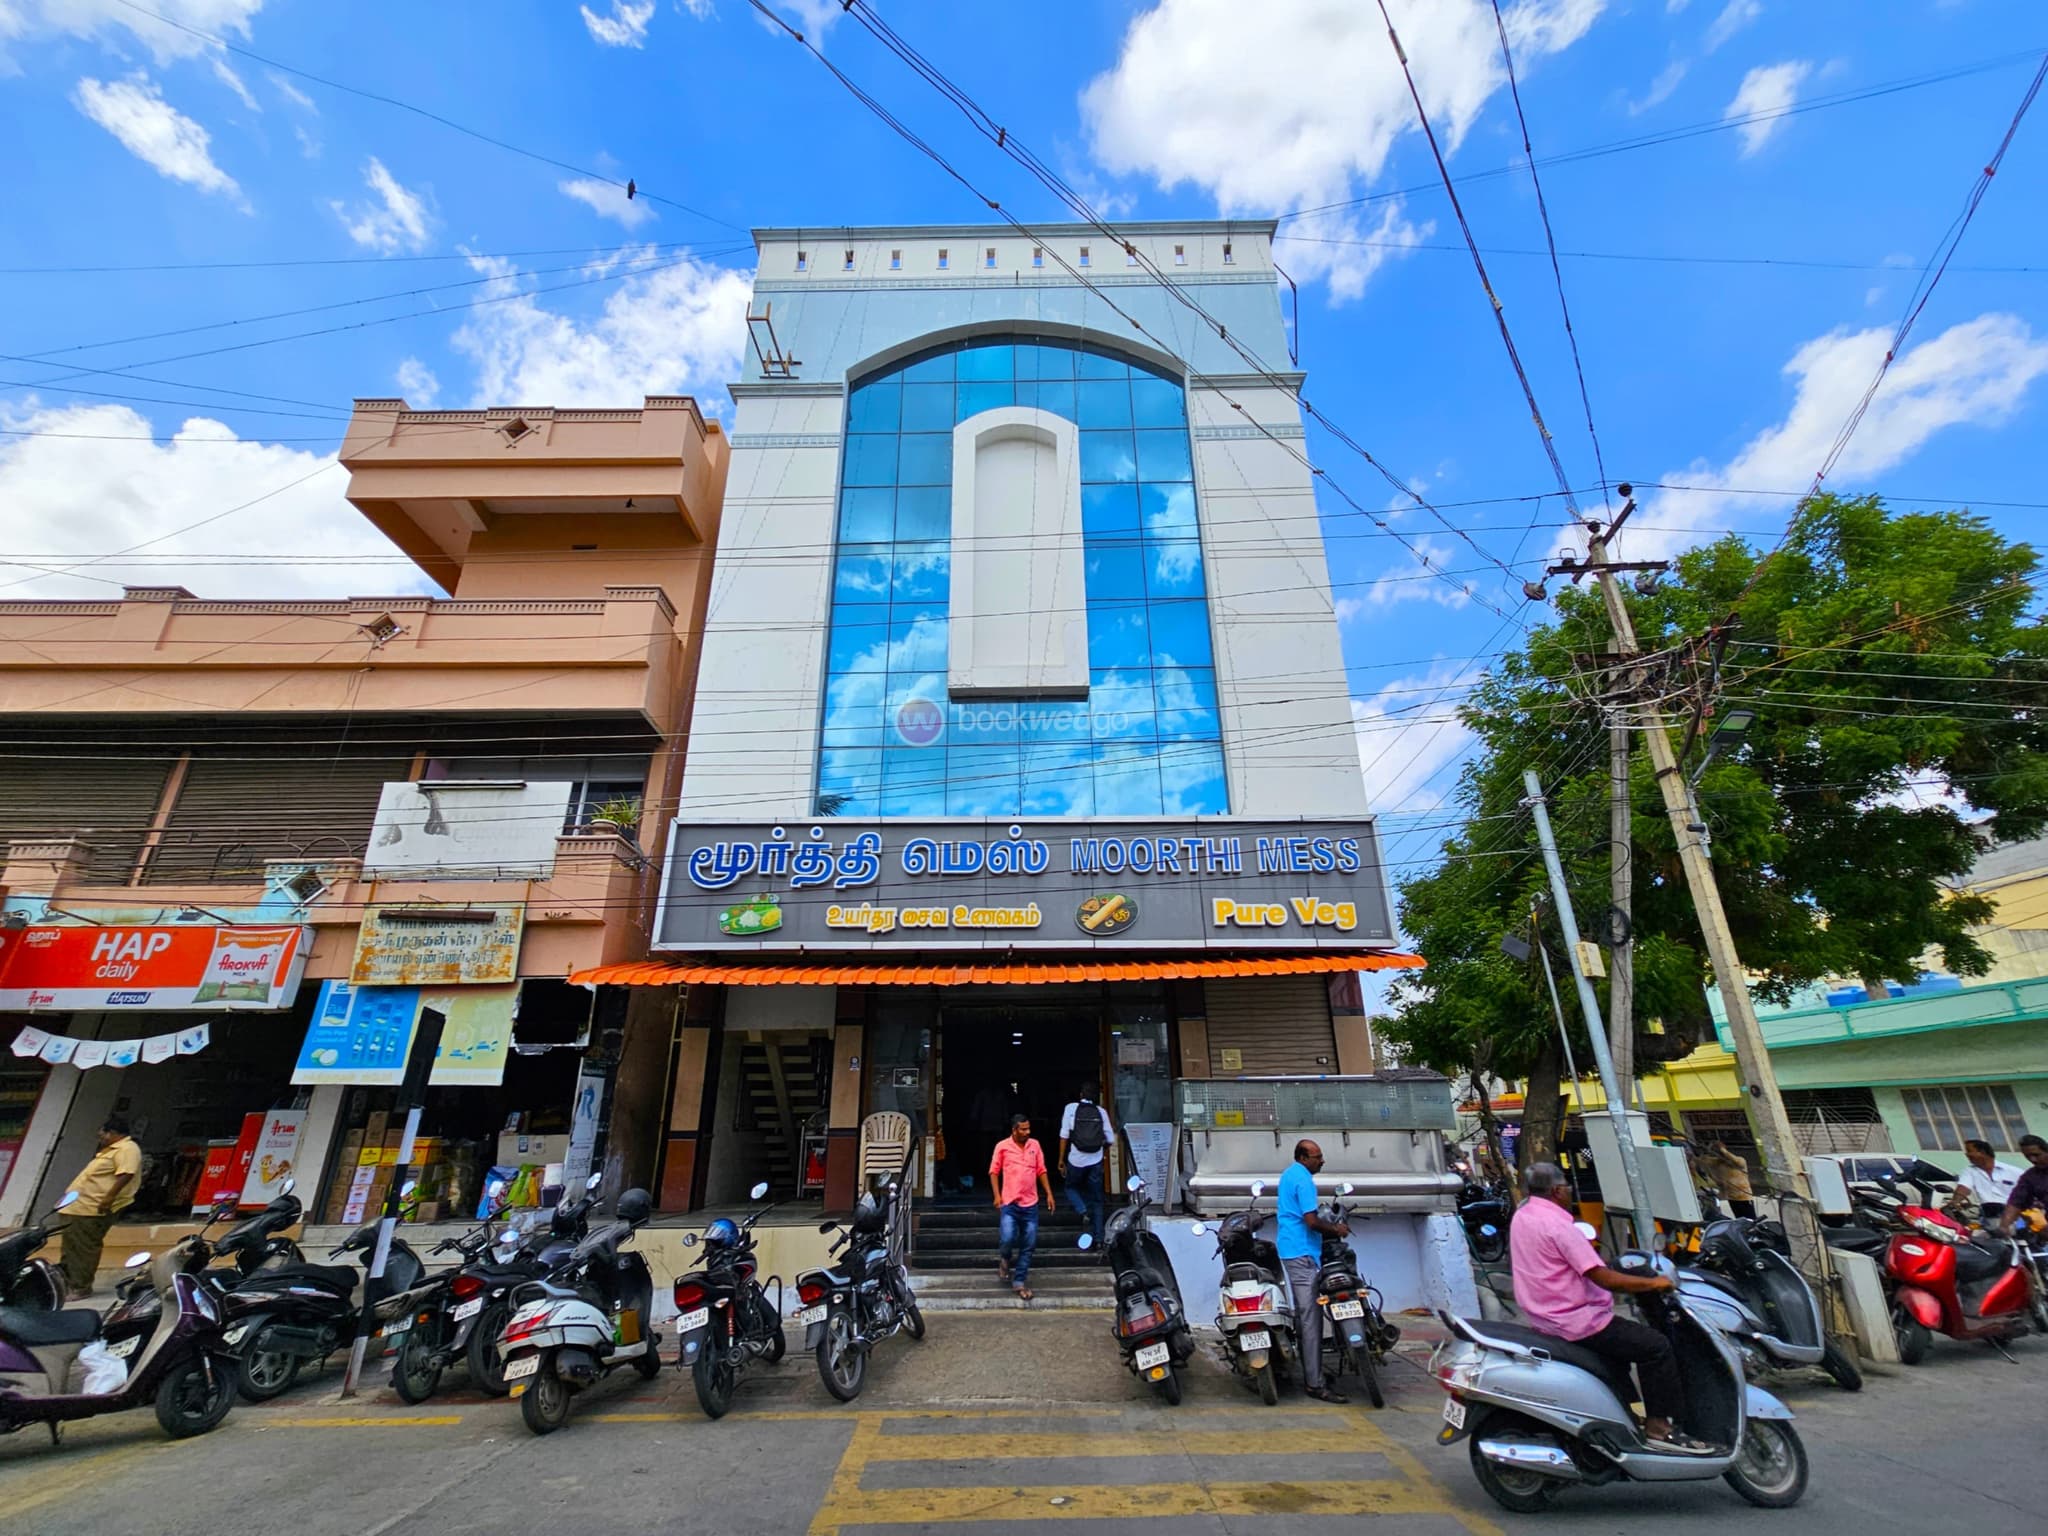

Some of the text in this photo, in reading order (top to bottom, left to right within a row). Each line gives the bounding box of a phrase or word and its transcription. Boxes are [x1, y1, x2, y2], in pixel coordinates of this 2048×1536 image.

[688, 824, 1049, 890] மூர்த்தி மெஸ்
[1070, 837, 1361, 875] MOORTHI MESS
[825, 902, 1042, 934] உயர்தர சைவ உணவகம்
[1212, 896, 1358, 931] Pure Veg
[90, 932, 172, 961] HAP
[96, 961, 140, 981] daily
